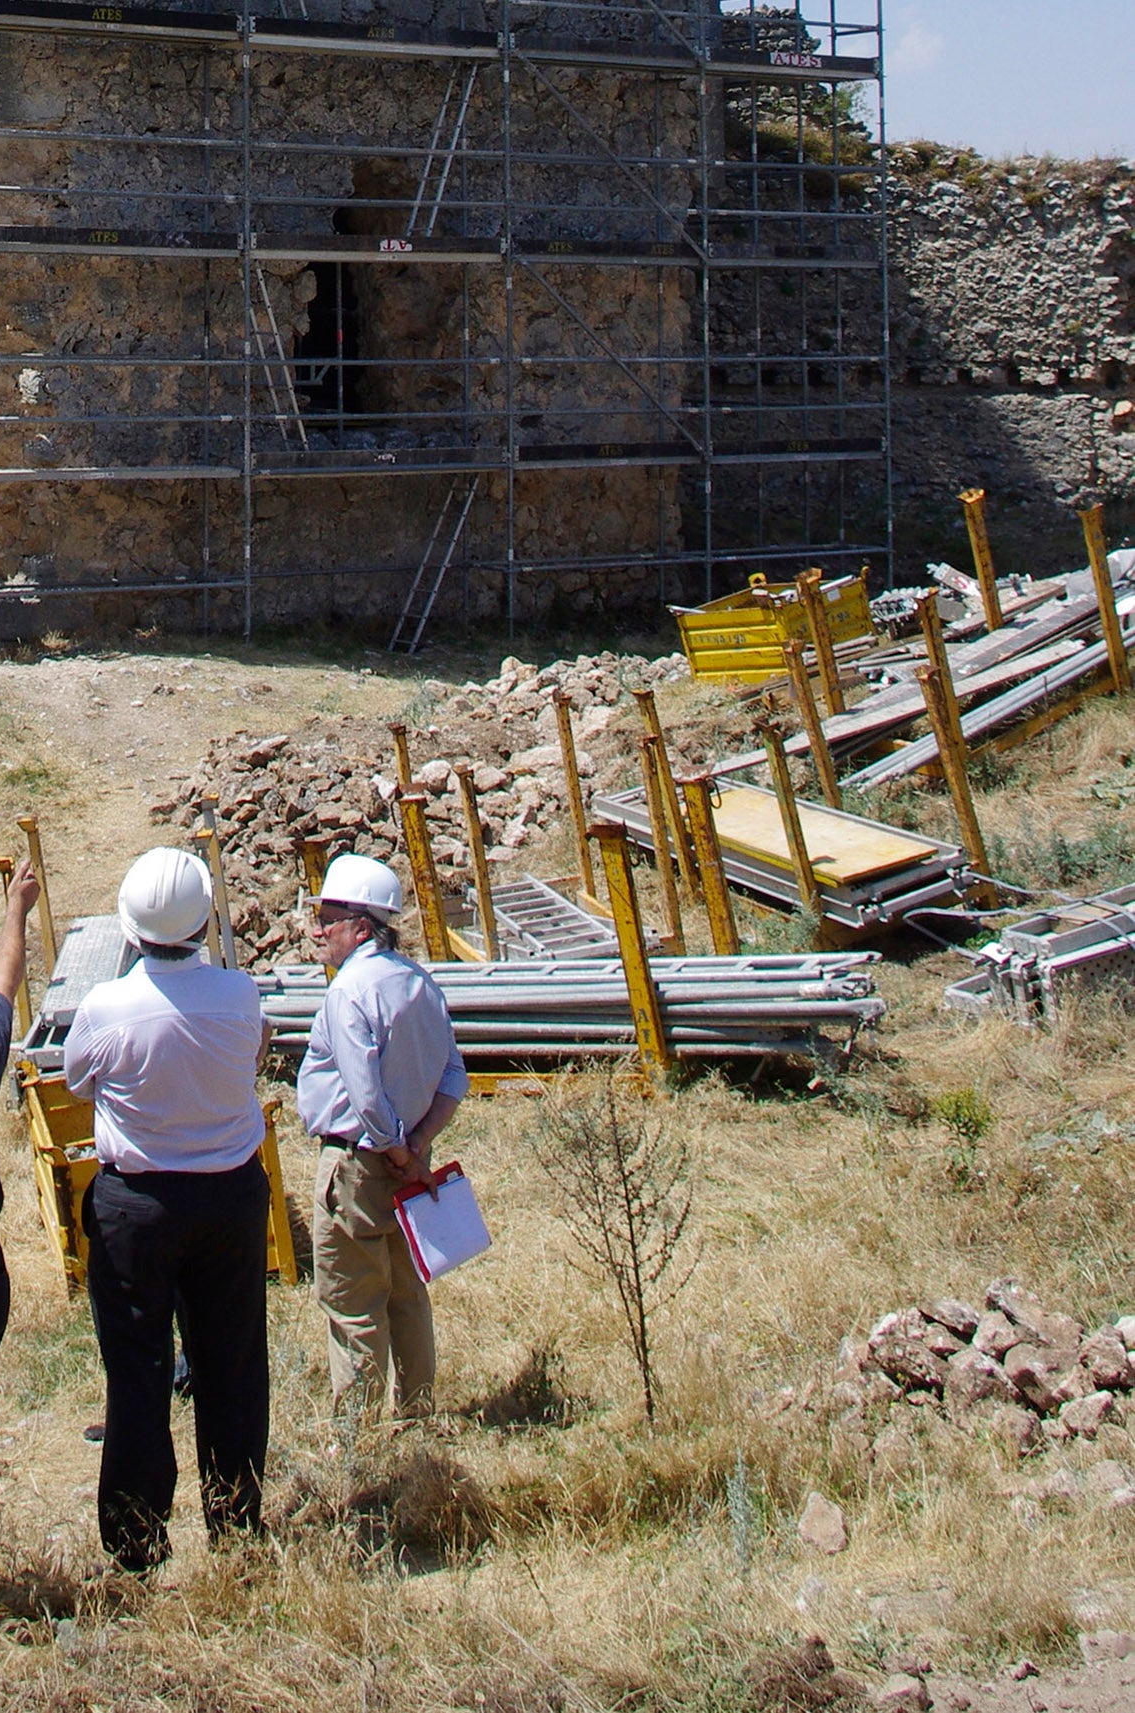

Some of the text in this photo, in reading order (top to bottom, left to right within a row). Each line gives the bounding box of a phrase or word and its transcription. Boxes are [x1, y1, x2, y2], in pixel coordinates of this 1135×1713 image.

[92, 9, 122, 21] ATES
[367, 26, 394, 39] ATES
[773, 53, 820, 67] ATES
[88, 231, 118, 243] ATES
[547, 241, 573, 253] ATES
[650, 244, 674, 256] ATES
